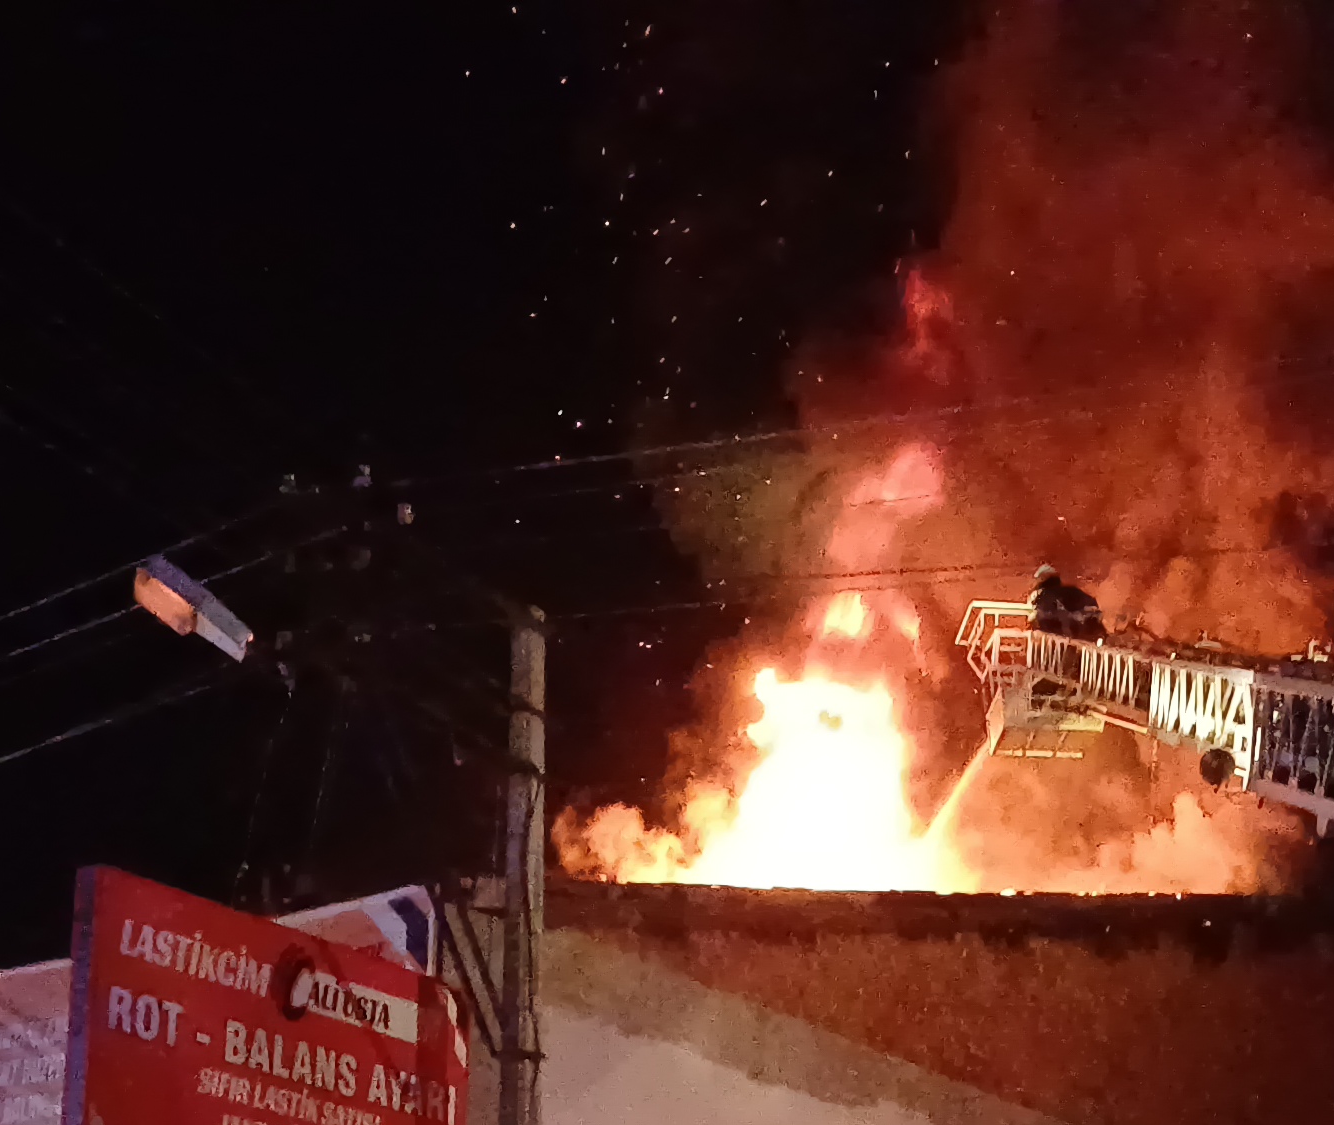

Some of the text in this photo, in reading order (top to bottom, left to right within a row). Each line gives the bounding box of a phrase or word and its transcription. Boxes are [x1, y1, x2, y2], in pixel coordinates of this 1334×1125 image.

[120, 919, 272, 998] LASTİKCİM
[107, 986, 184, 1046] ROT
[224, 1019, 357, 1096] BALANS
